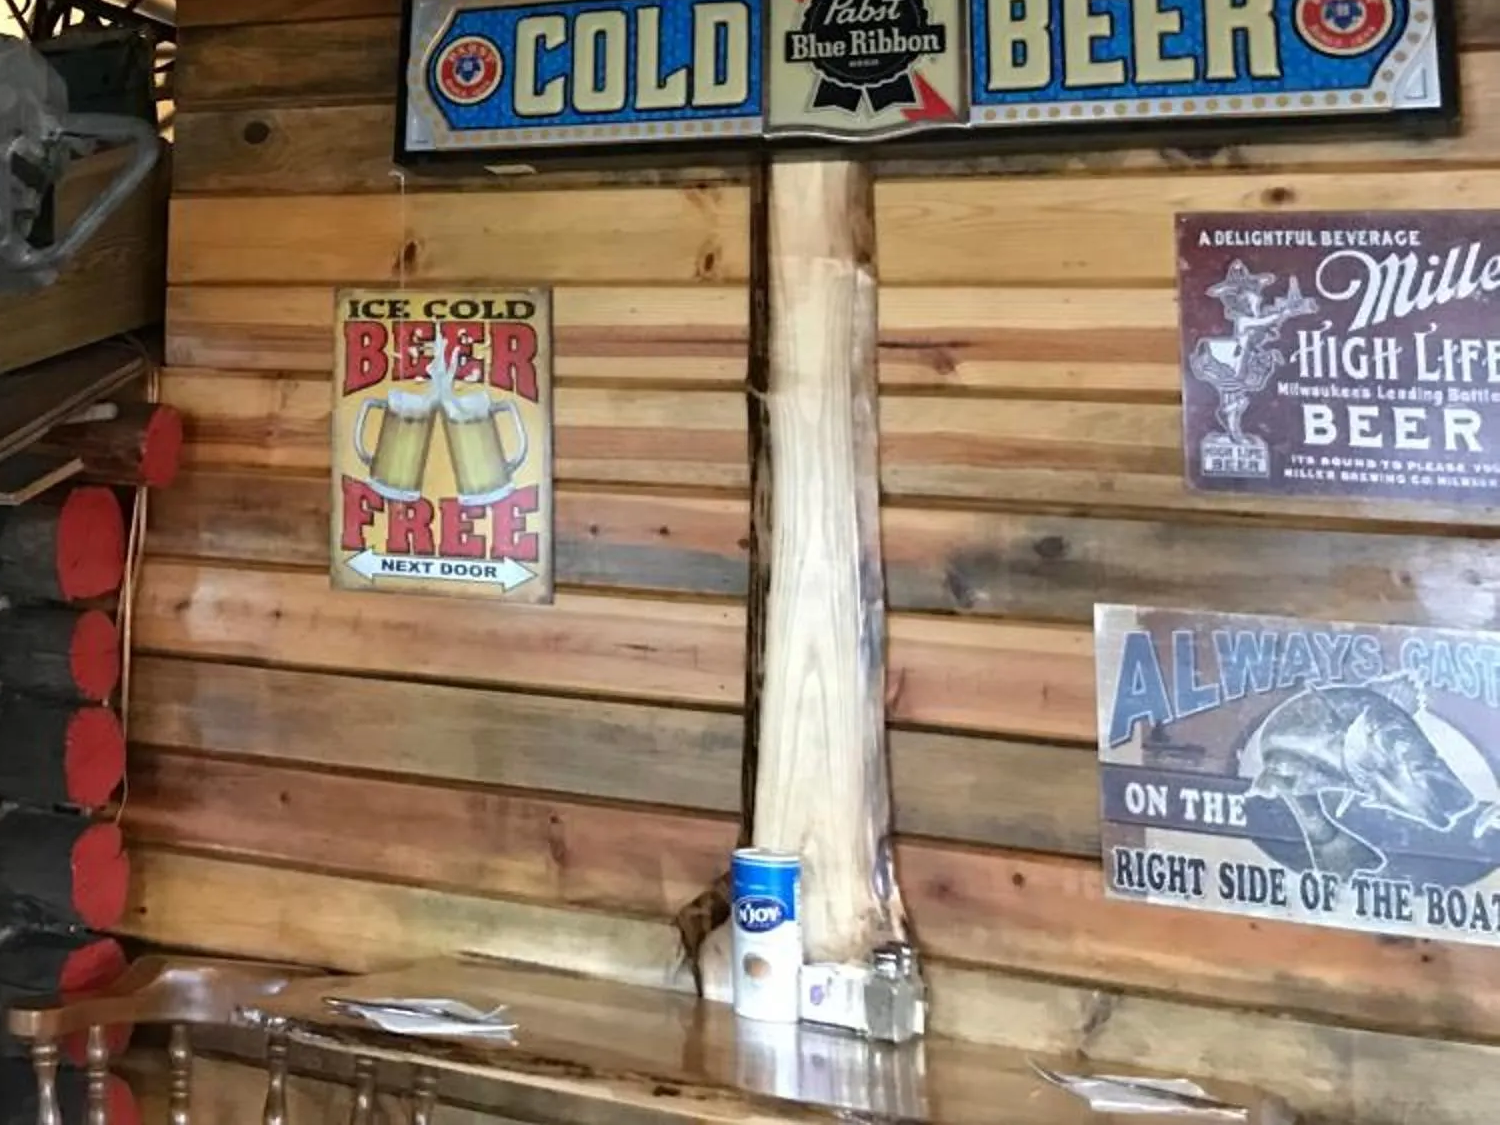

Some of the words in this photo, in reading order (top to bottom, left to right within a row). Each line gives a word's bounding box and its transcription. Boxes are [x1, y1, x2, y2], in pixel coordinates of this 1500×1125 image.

[513, 0, 750, 118] COLD
[790, 32, 847, 60] Blue
[850, 27, 942, 57] Ribbon
[1199, 230, 1211, 246] A
[1214, 229, 1316, 246] DELIGHTFUL
[1321, 229, 1421, 246] BEVERAGE
[348, 299, 411, 319] ICE
[423, 299, 535, 320] COLD
[342, 320, 539, 403] BEER
[1289, 319, 1403, 381] HIGH
[1414, 322, 1500, 383] LIFE
[1377, 384, 1443, 406] Leading
[1303, 403, 1484, 452] BEER
[1407, 461, 1466, 473] PLEASE
[341, 474, 540, 563] FREE
[380, 558, 436, 575] NEXT
[440, 560, 498, 578] DOOR
[1109, 630, 1385, 750] ALWAYS
[1399, 637, 1500, 708] CAST
[1124, 781, 1169, 817] ON
[1180, 787, 1248, 828] THE
[1113, 847, 1206, 897] RIGHT
[1219, 861, 1288, 908] SIDE
[1300, 871, 1341, 913] OF
[1352, 875, 1414, 923] THE
